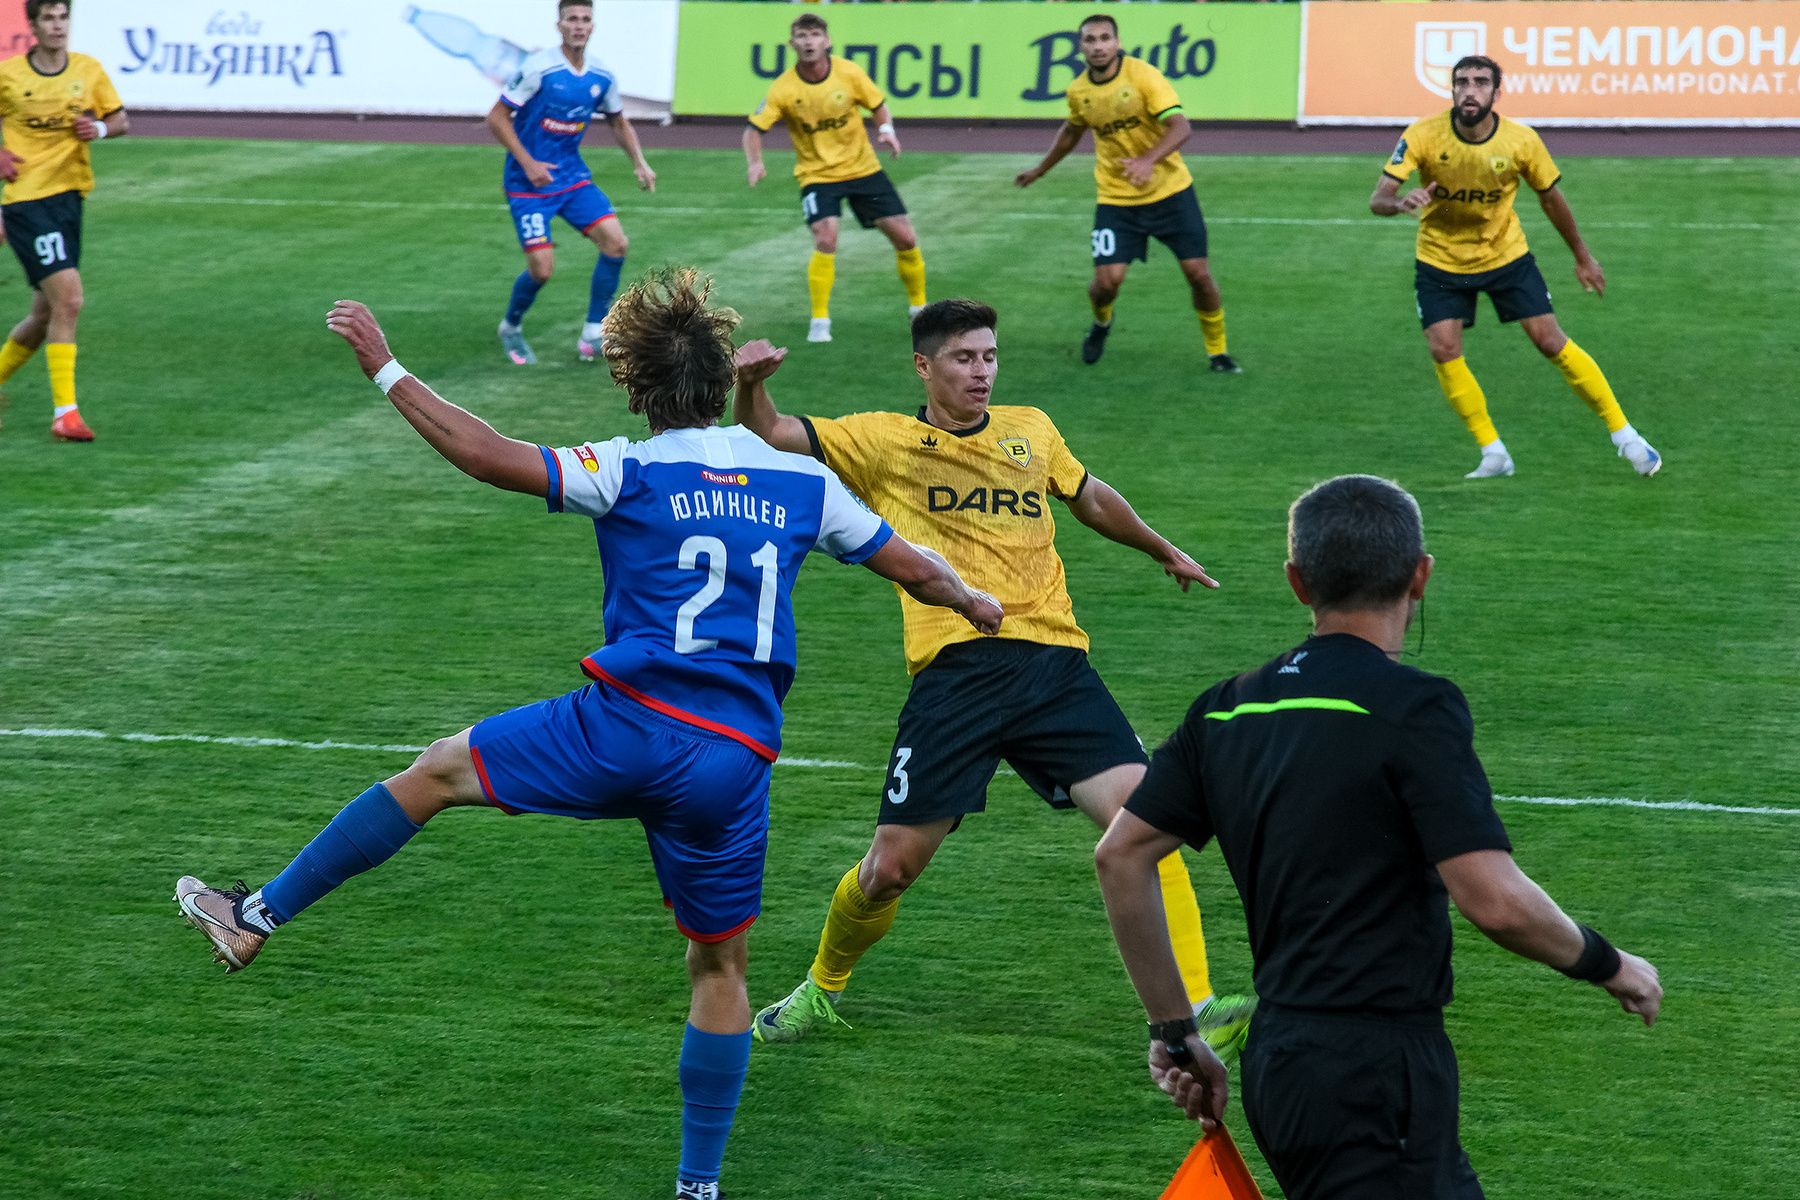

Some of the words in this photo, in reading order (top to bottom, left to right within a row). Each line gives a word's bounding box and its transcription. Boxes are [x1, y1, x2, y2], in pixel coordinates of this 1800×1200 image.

[751, 43, 981, 99] ЧПСЫ
[1020, 24, 1216, 101] Buto
[1502, 71, 1800, 95] WWW.CHAMPIONAT.
[1434, 185, 1503, 204] DARS
[521, 212, 546, 239] 59
[34, 231, 67, 265] 97
[669, 489, 787, 530] ЮДИНЦЕВ
[928, 486, 1042, 519] DARS
[674, 535, 779, 664] 21
[887, 747, 913, 805] 3
